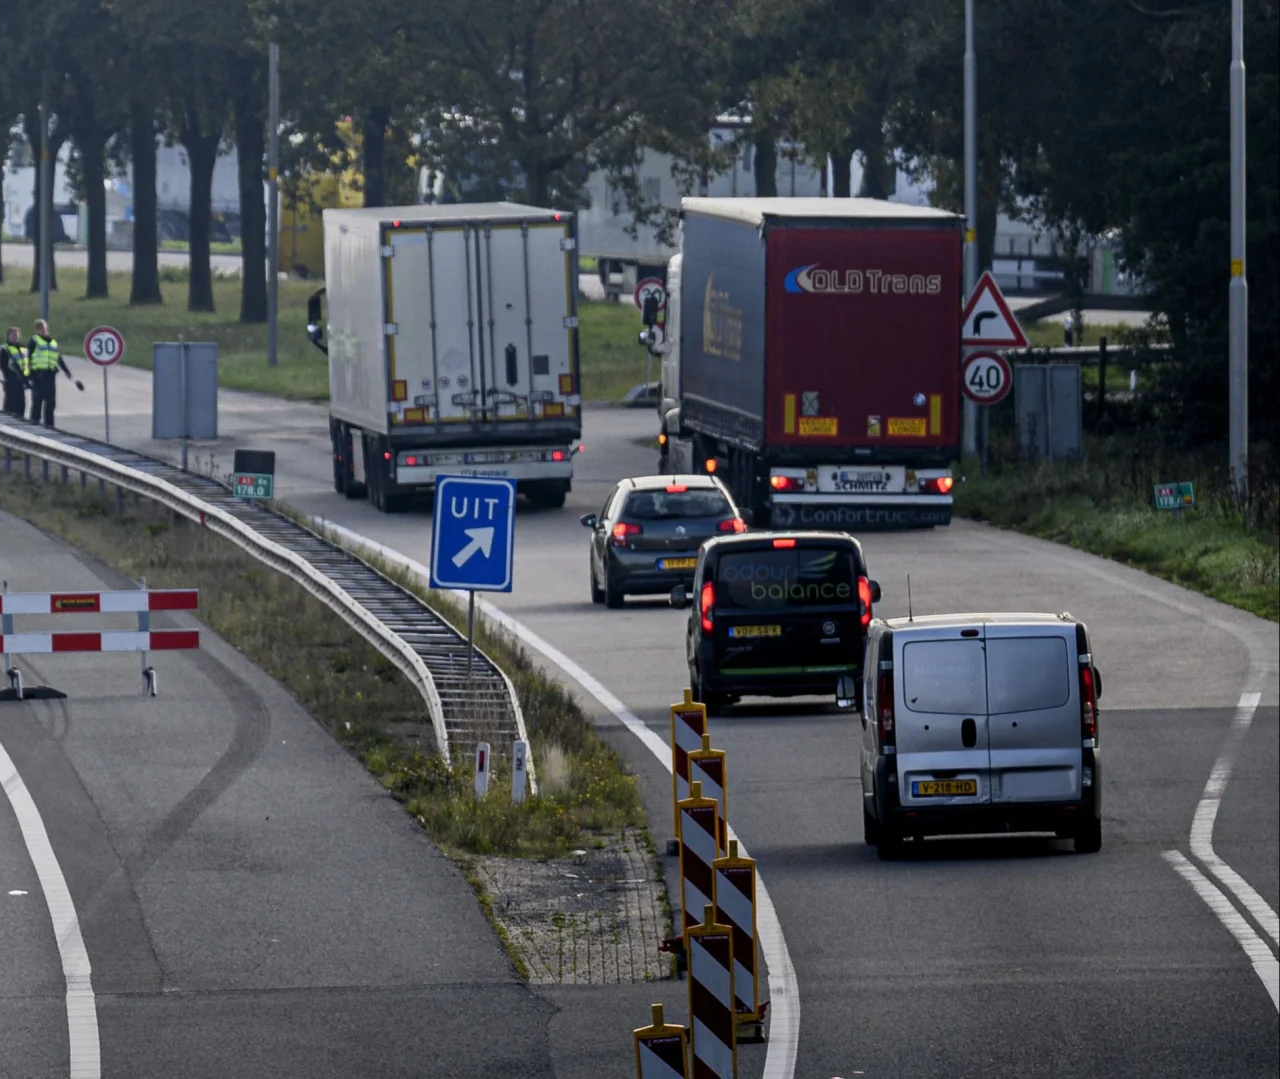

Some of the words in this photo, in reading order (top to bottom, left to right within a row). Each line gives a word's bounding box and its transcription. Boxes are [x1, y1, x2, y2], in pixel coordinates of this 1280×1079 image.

[866, 269, 942, 295] Trans
[92, 337, 116, 356] 30
[969, 365, 1000, 390] 40
[242, 477, 252, 485] A1
[834, 481, 887, 491] SCHMITZ
[451, 496, 499, 520] UIT
[724, 562, 792, 582] odour
[751, 581, 850, 600] balance
[922, 782, 972, 793] V-218-HD
